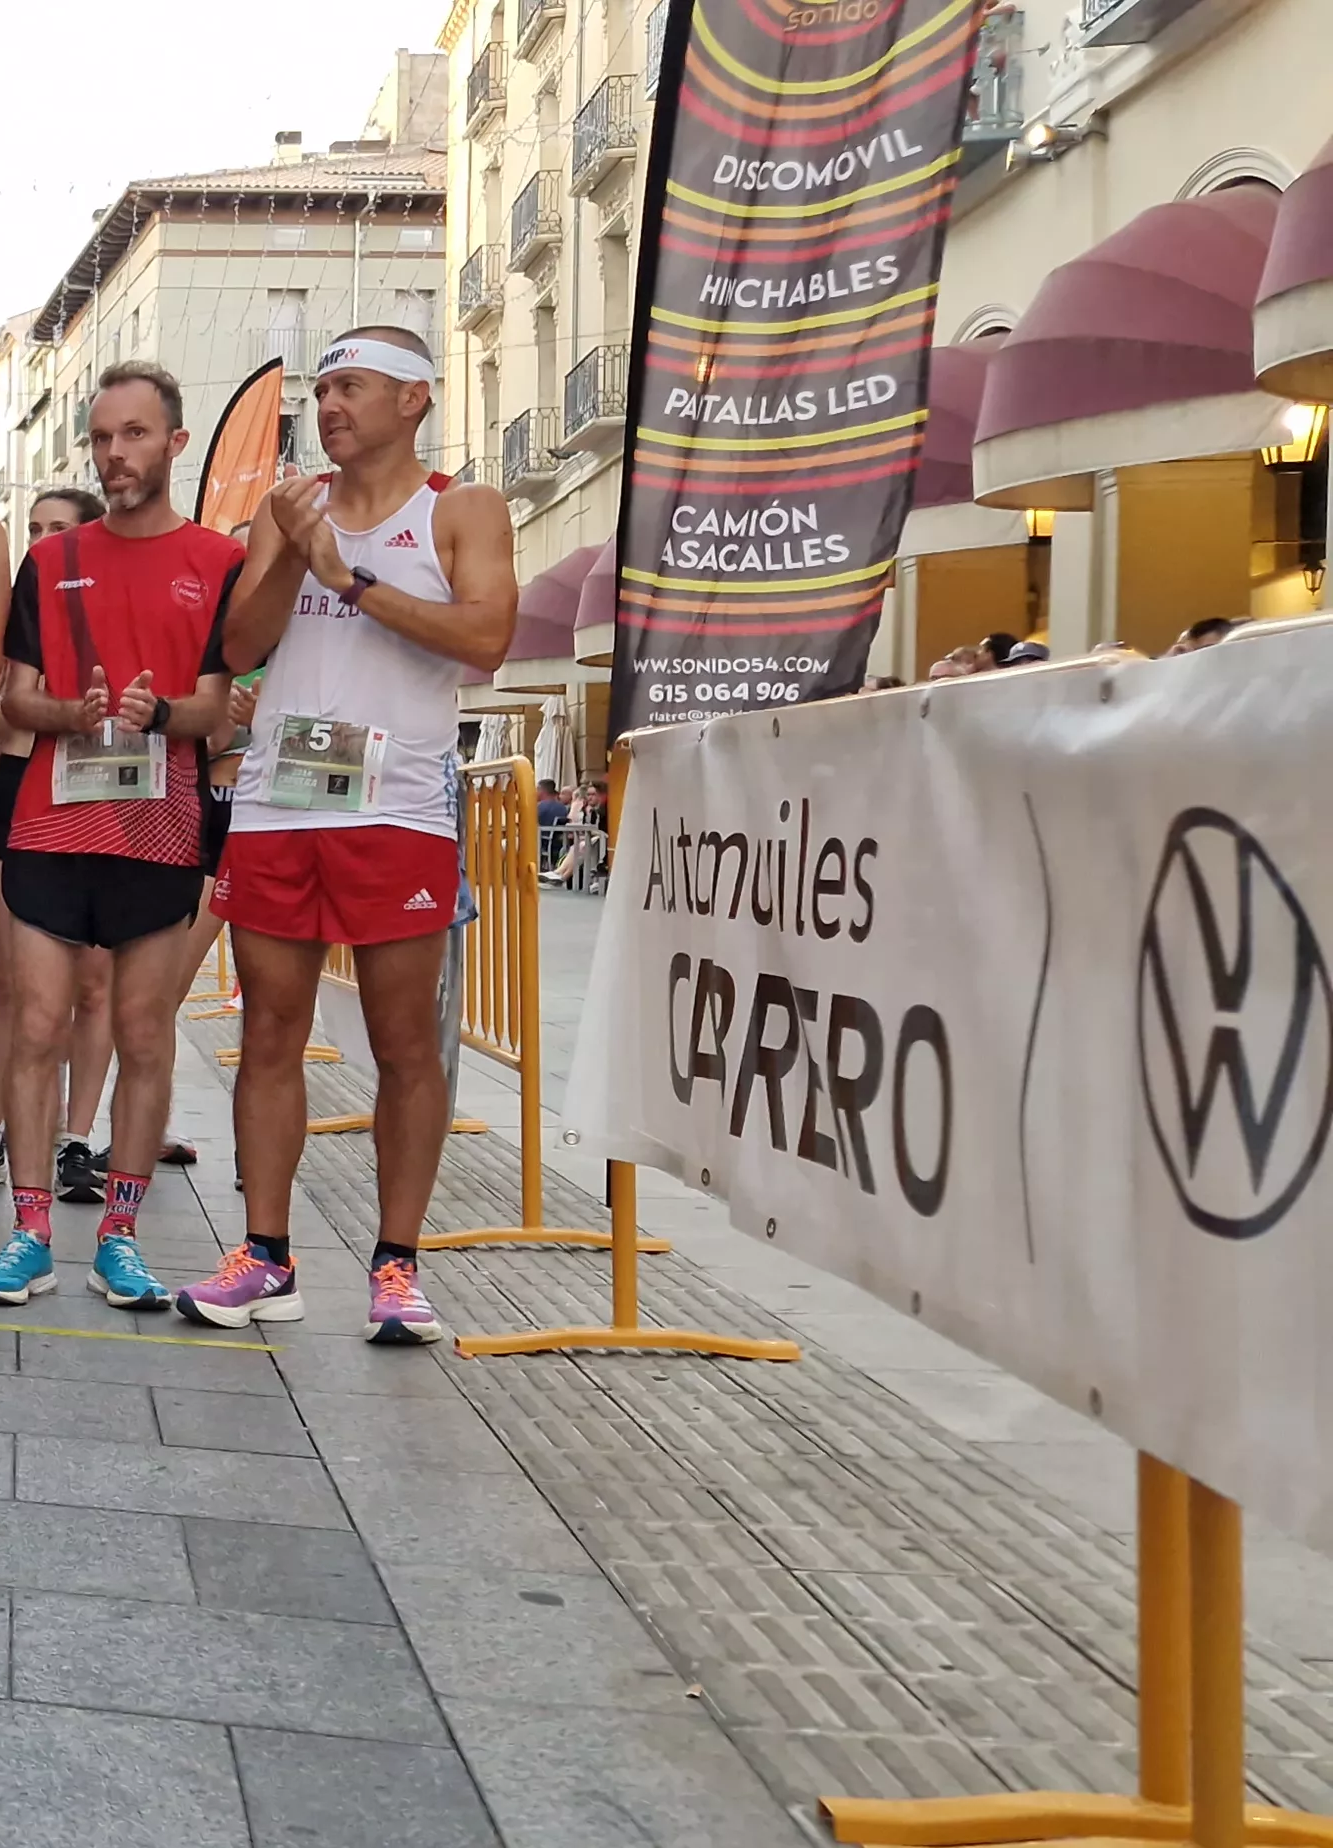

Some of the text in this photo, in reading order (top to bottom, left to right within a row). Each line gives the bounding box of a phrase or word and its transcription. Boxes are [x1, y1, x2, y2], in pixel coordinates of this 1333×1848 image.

[713, 129, 923, 191] DISCOMÓVIL
[827, 374, 898, 416] LED
[671, 500, 819, 538] CAMIÓN
[384, 539, 419, 549] adidas
[648, 682, 800, 703] 615 064 906
[308, 722, 333, 751] 5
[403, 900, 437, 910] adidas
